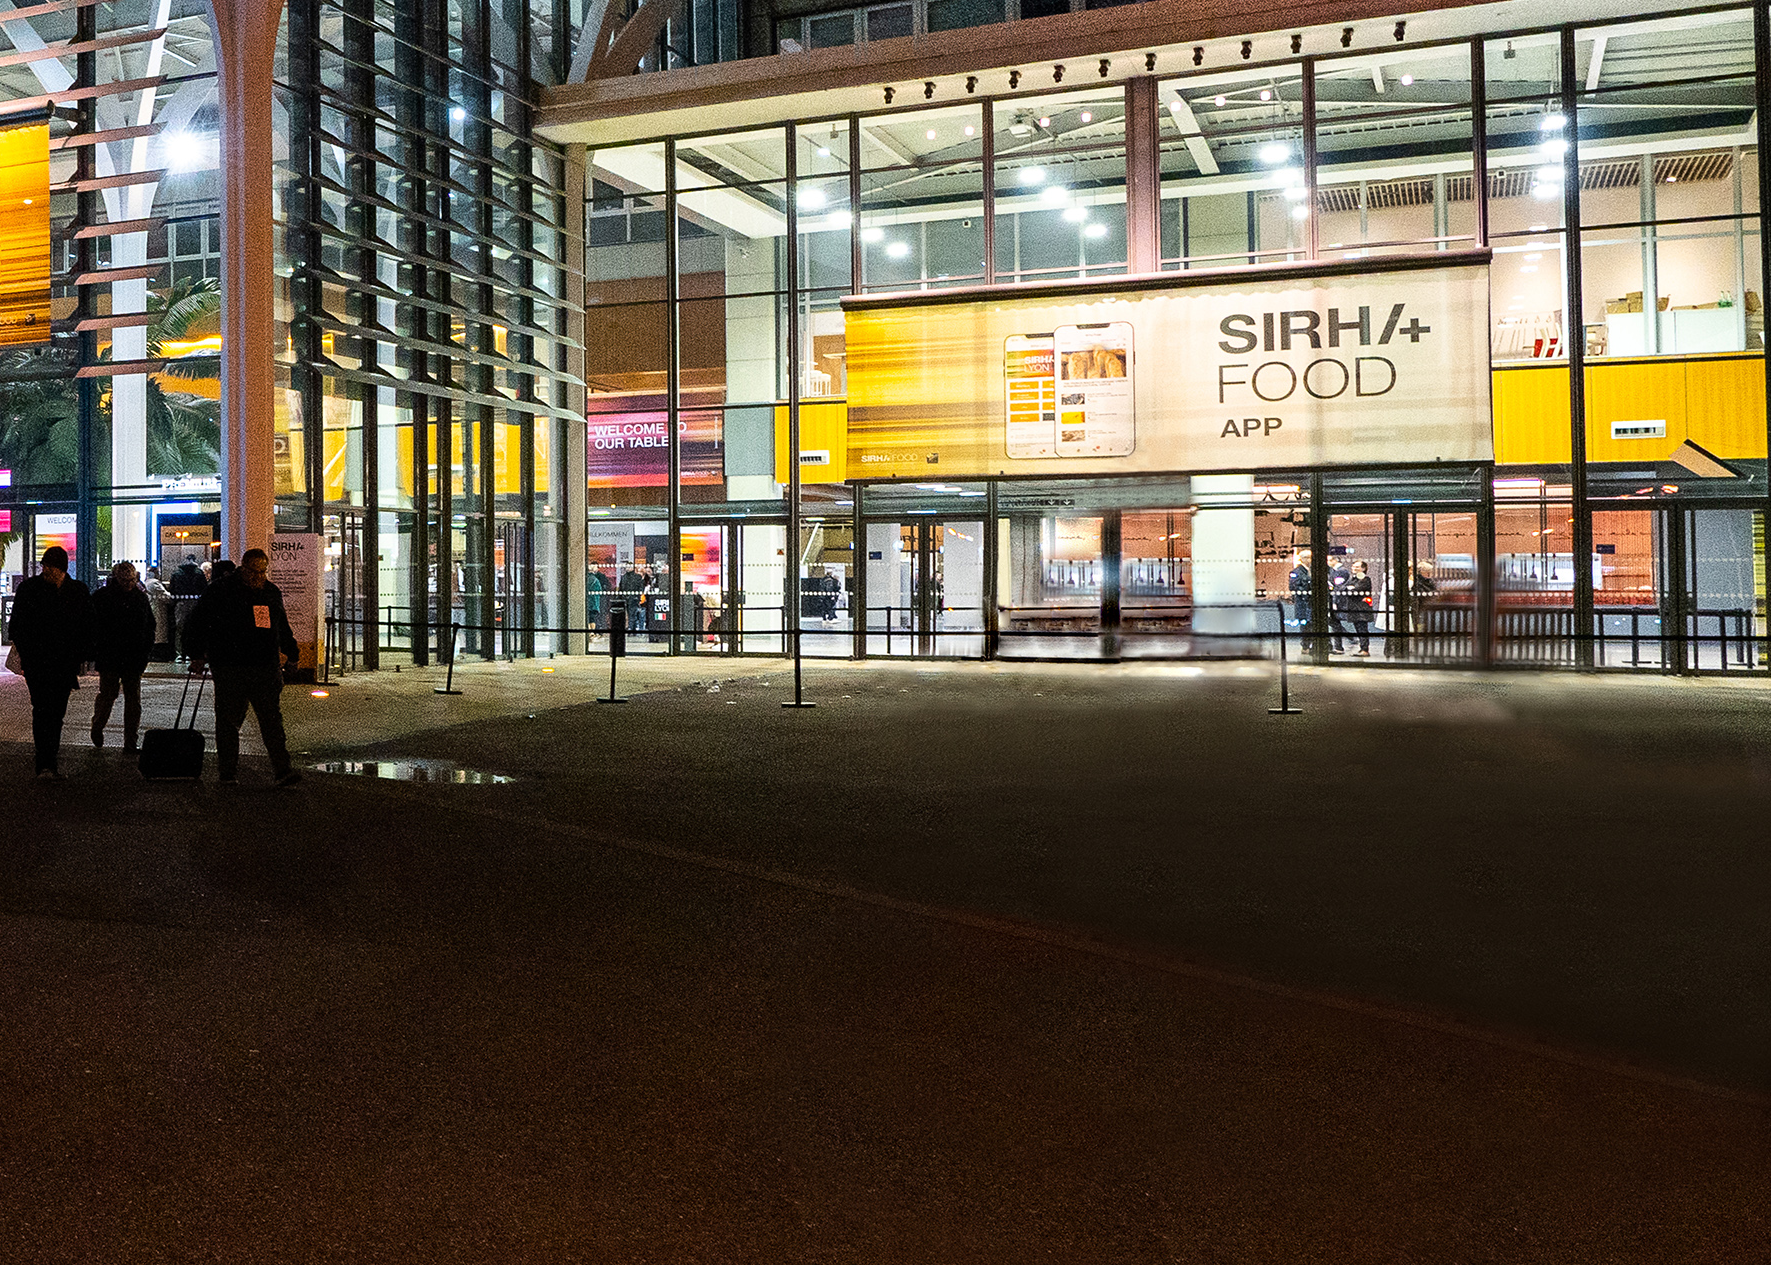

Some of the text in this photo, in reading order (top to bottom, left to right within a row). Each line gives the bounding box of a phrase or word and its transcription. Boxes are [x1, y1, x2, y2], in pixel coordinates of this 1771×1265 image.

[1218, 356, 1397, 403] FOOD
[594, 423, 665, 436] WELCOME
[1220, 417, 1283, 438] APP
[594, 436, 669, 449] OUR TABLE
[891, 453, 918, 461] FOOD
[271, 552, 297, 561] LYON
